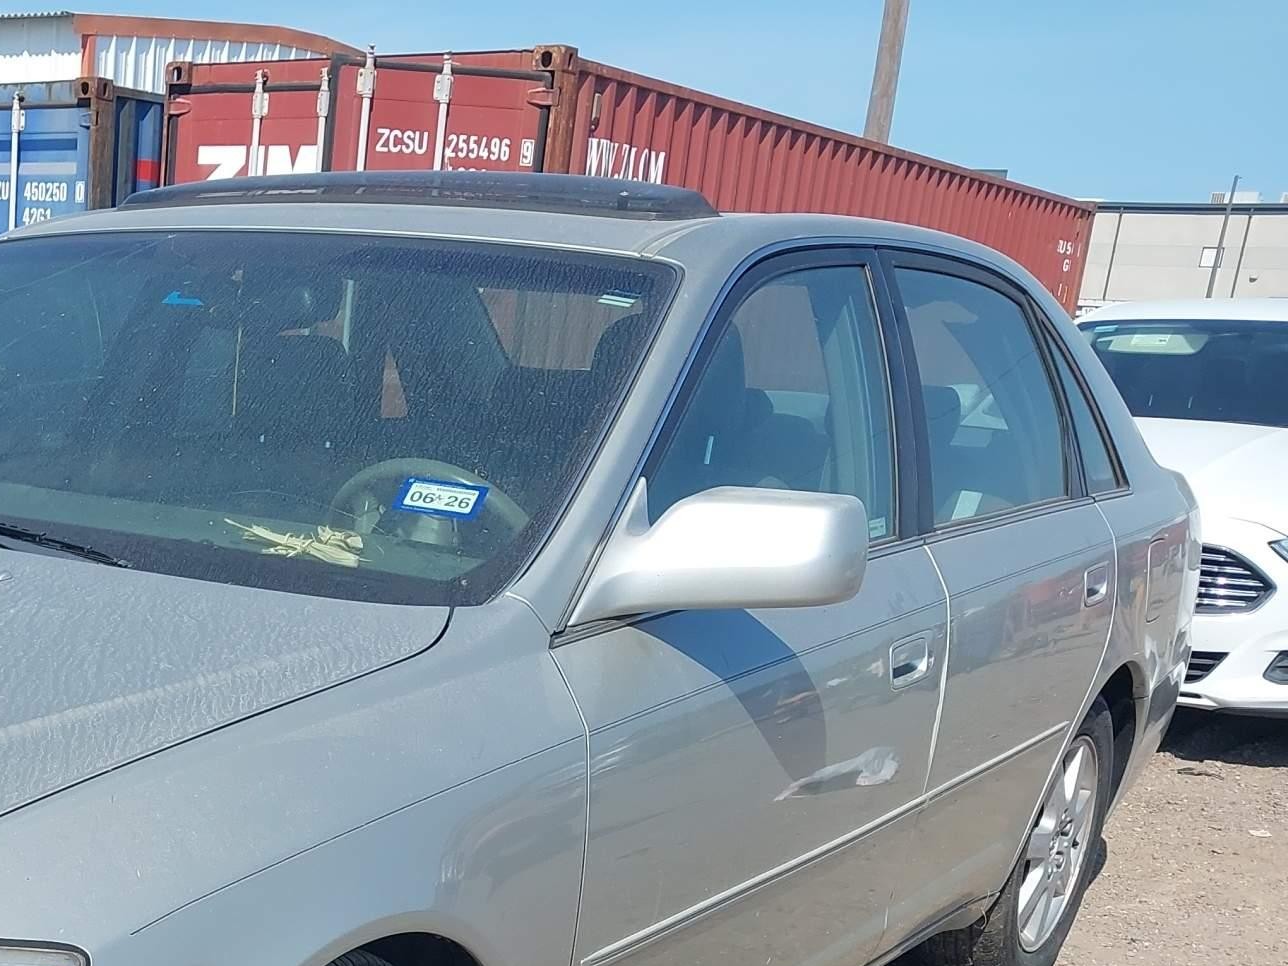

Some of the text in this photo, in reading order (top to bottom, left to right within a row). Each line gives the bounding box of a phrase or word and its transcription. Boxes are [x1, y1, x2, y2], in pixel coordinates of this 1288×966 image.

[376, 128, 534, 164] ZCSU 255496 9
[23, 182, 68, 202] 450250
[76, 182, 85, 202] 0
[410, 490, 436, 505] 06
[444, 495, 472, 509] 26
